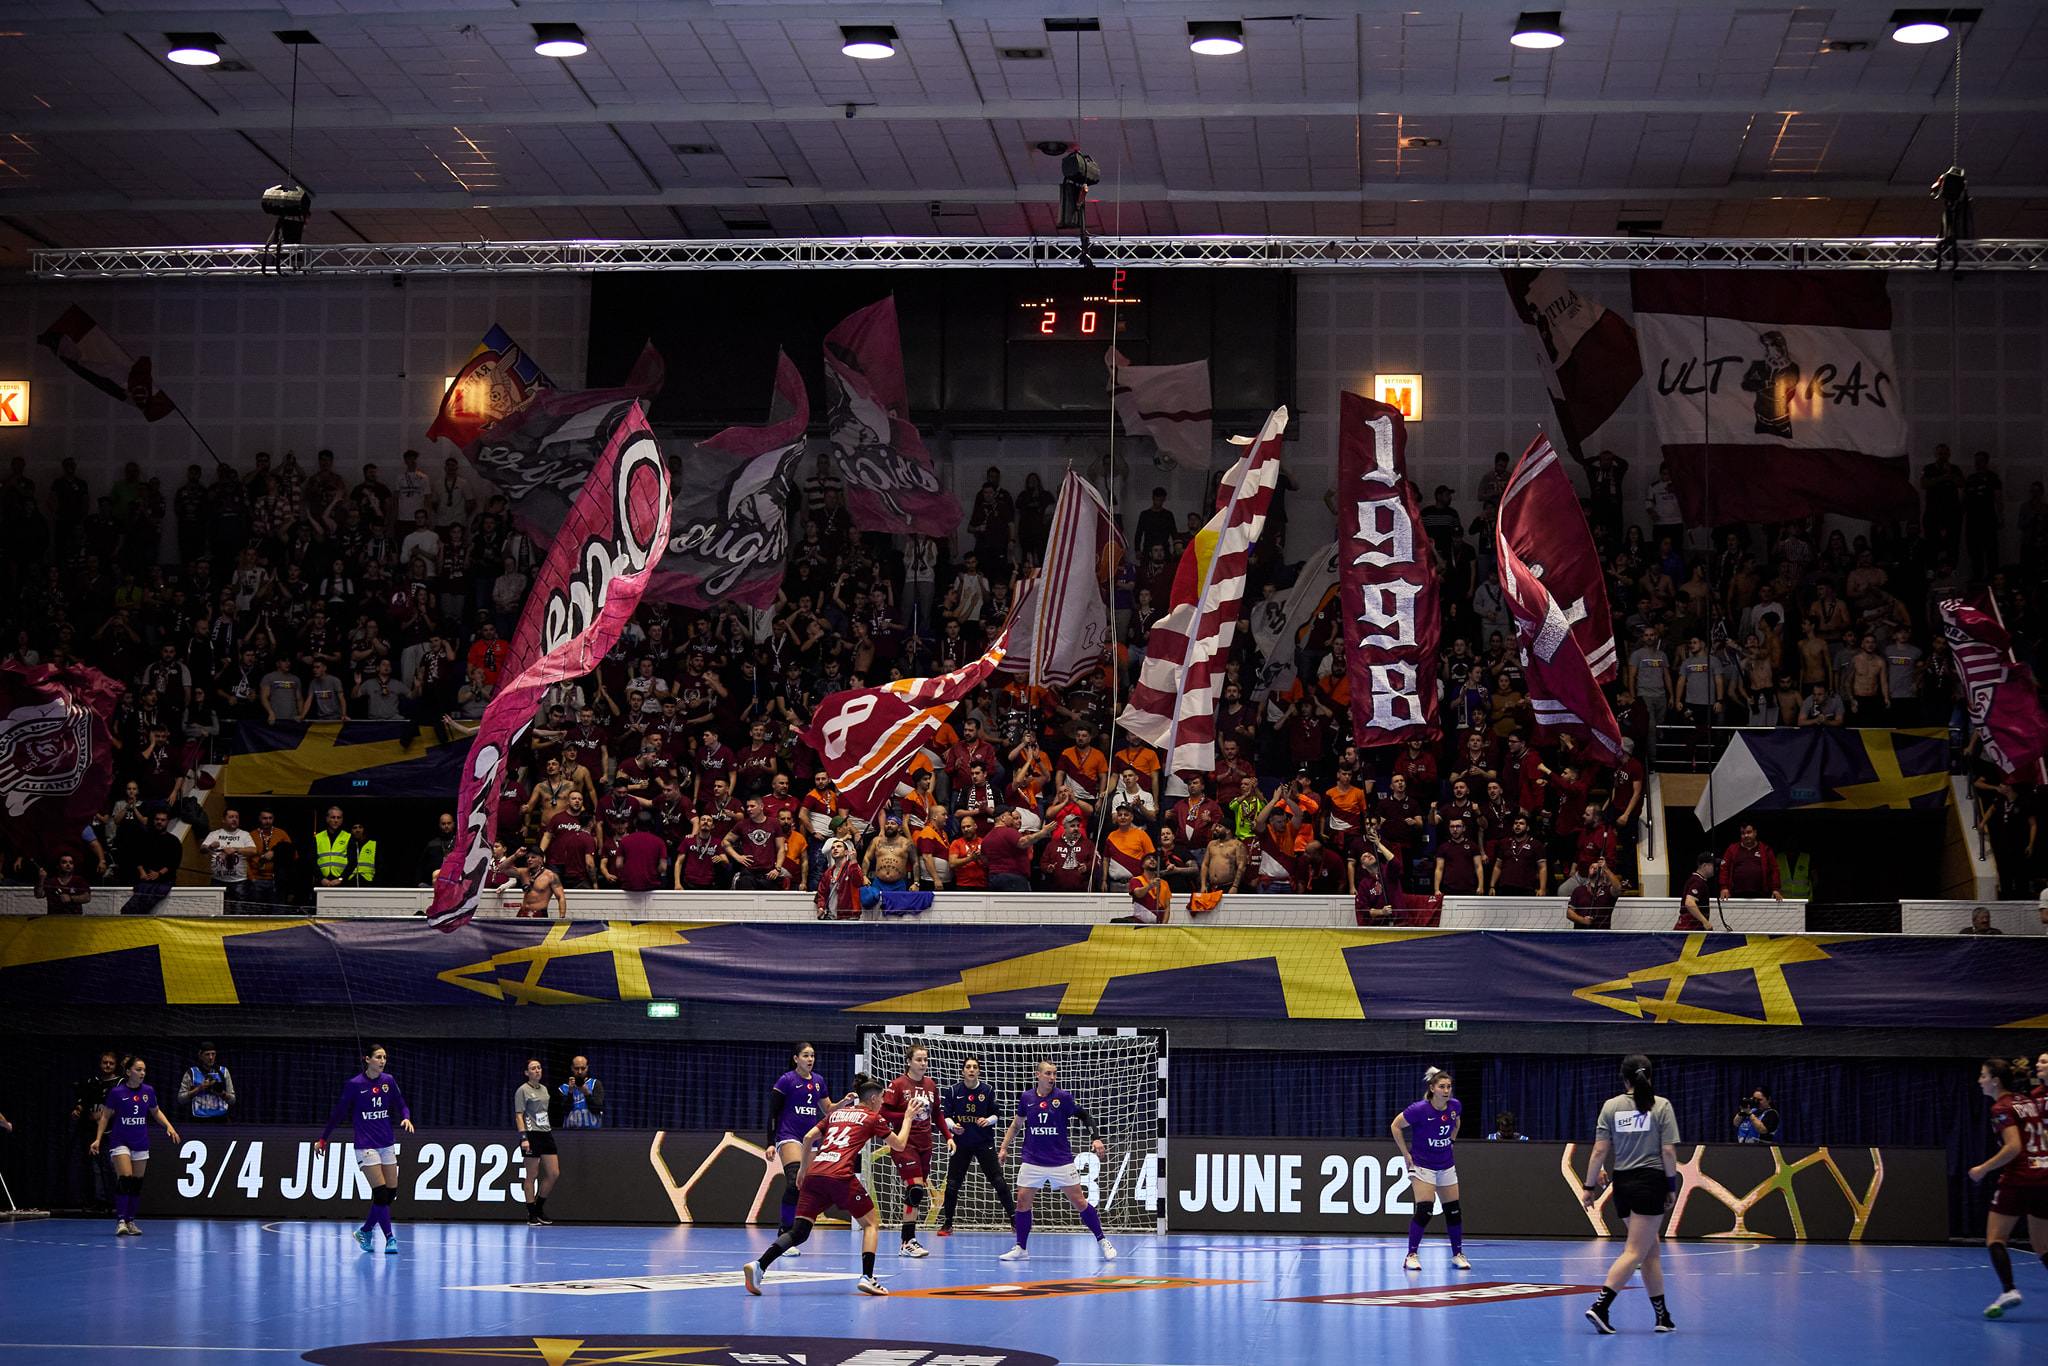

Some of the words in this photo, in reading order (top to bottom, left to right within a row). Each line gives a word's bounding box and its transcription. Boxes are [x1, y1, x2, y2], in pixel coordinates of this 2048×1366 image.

[1041, 311, 1056, 333] 2
[1081, 311, 1096, 333] 0
[1385, 388, 1411, 416] M
[352, 779, 369, 787] EXIT
[1431, 1020, 1452, 1029] EXIT
[371, 1096, 382, 1108] 14
[807, 1093, 813, 1104] 2
[133, 1105, 139, 1115] 3
[965, 1103, 976, 1113] 58
[362, 1110, 390, 1121] VESTEL
[1037, 1112, 1049, 1124] 17
[1618, 1117, 1633, 1126] EHF
[1633, 1113, 1648, 1129] TV
[1029, 1126, 1059, 1136] VESTEL
[1439, 1125, 1450, 1136] 37
[820, 1126, 852, 1151] 34
[176, 1140, 264, 1199] 3/4
[1179, 1153, 1302, 1214] JUNE
